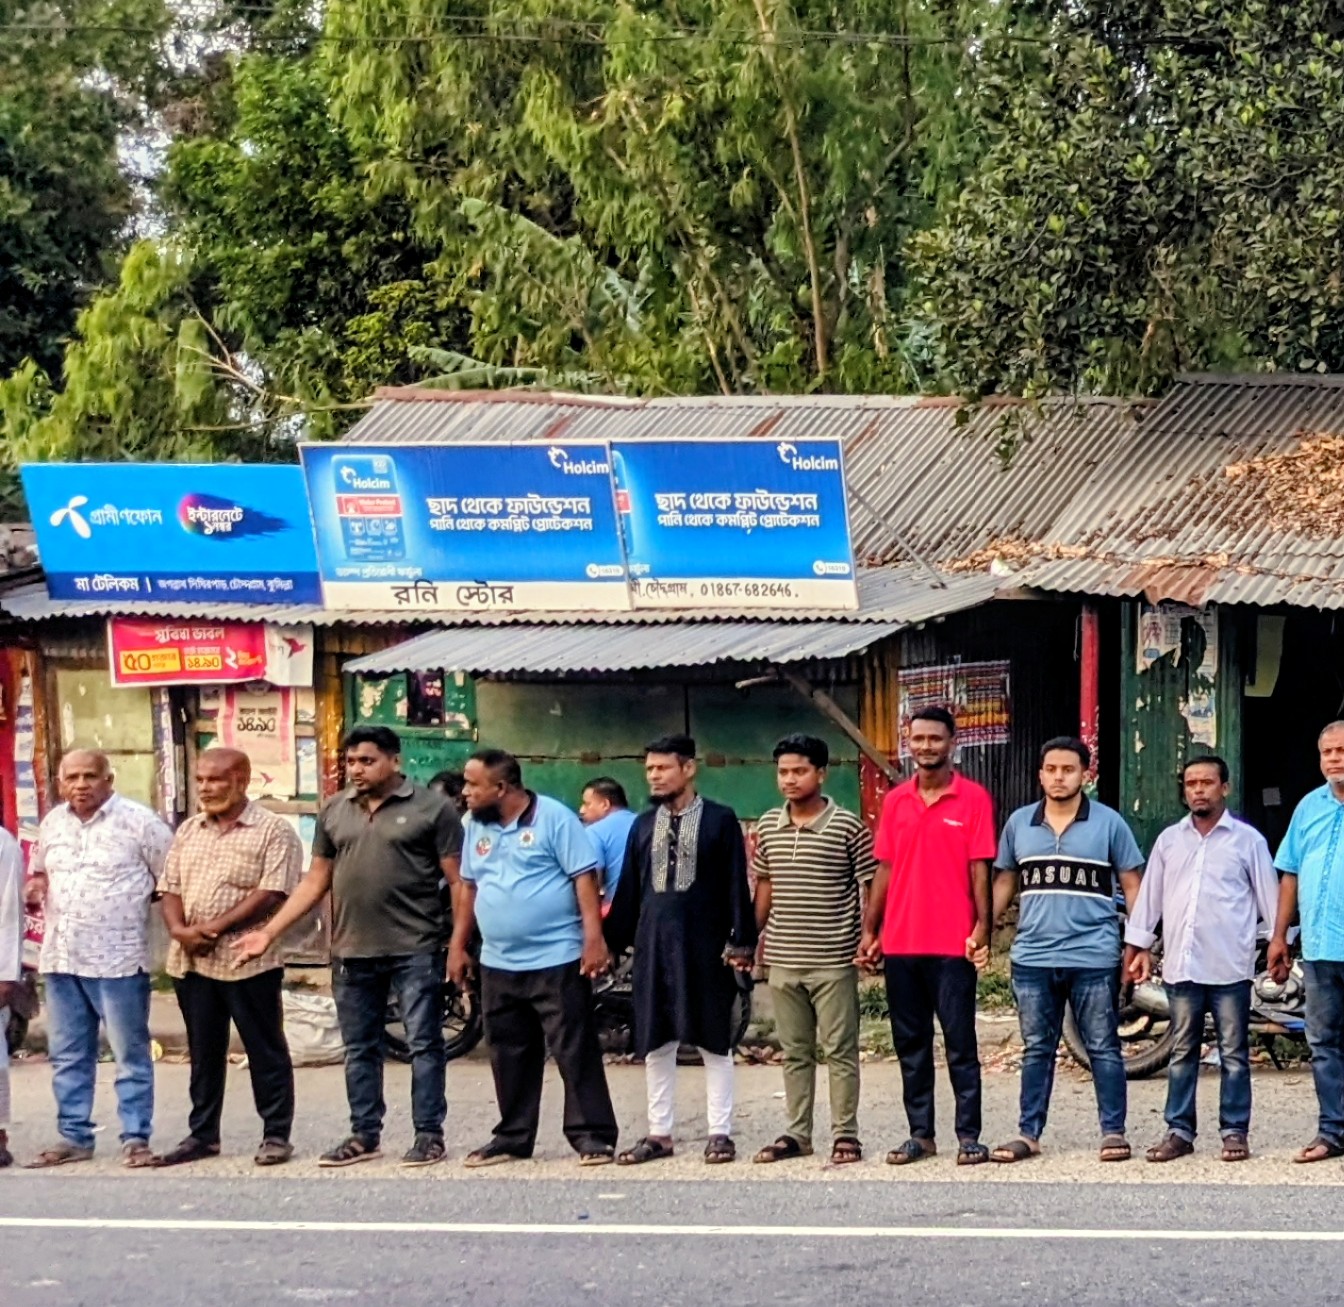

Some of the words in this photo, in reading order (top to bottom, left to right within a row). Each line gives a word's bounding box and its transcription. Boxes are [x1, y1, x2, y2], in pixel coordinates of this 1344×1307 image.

[563, 461, 609, 474] Holcim
[793, 456, 838, 470] Holcim
[353, 477, 390, 489] Holcim
[426, 497, 457, 515] ছাদ
[461, 497, 503, 514] থেকে
[505, 492, 591, 515] ফাউন্ডেশন
[655, 493, 686, 511] ছাদ
[689, 493, 731, 510] থেকে
[734, 488, 818, 511] ফাউন্ডেশন
[429, 515, 455, 531] পানি
[456, 518, 486, 531] থেকে
[657, 510, 683, 527] পানি
[684, 514, 714, 527] থেকে
[74, 577, 89, 592] মা
[92, 573, 139, 592] টেলিকম
[390, 578, 439, 606] রনি
[456, 578, 515, 606] স্টোর
